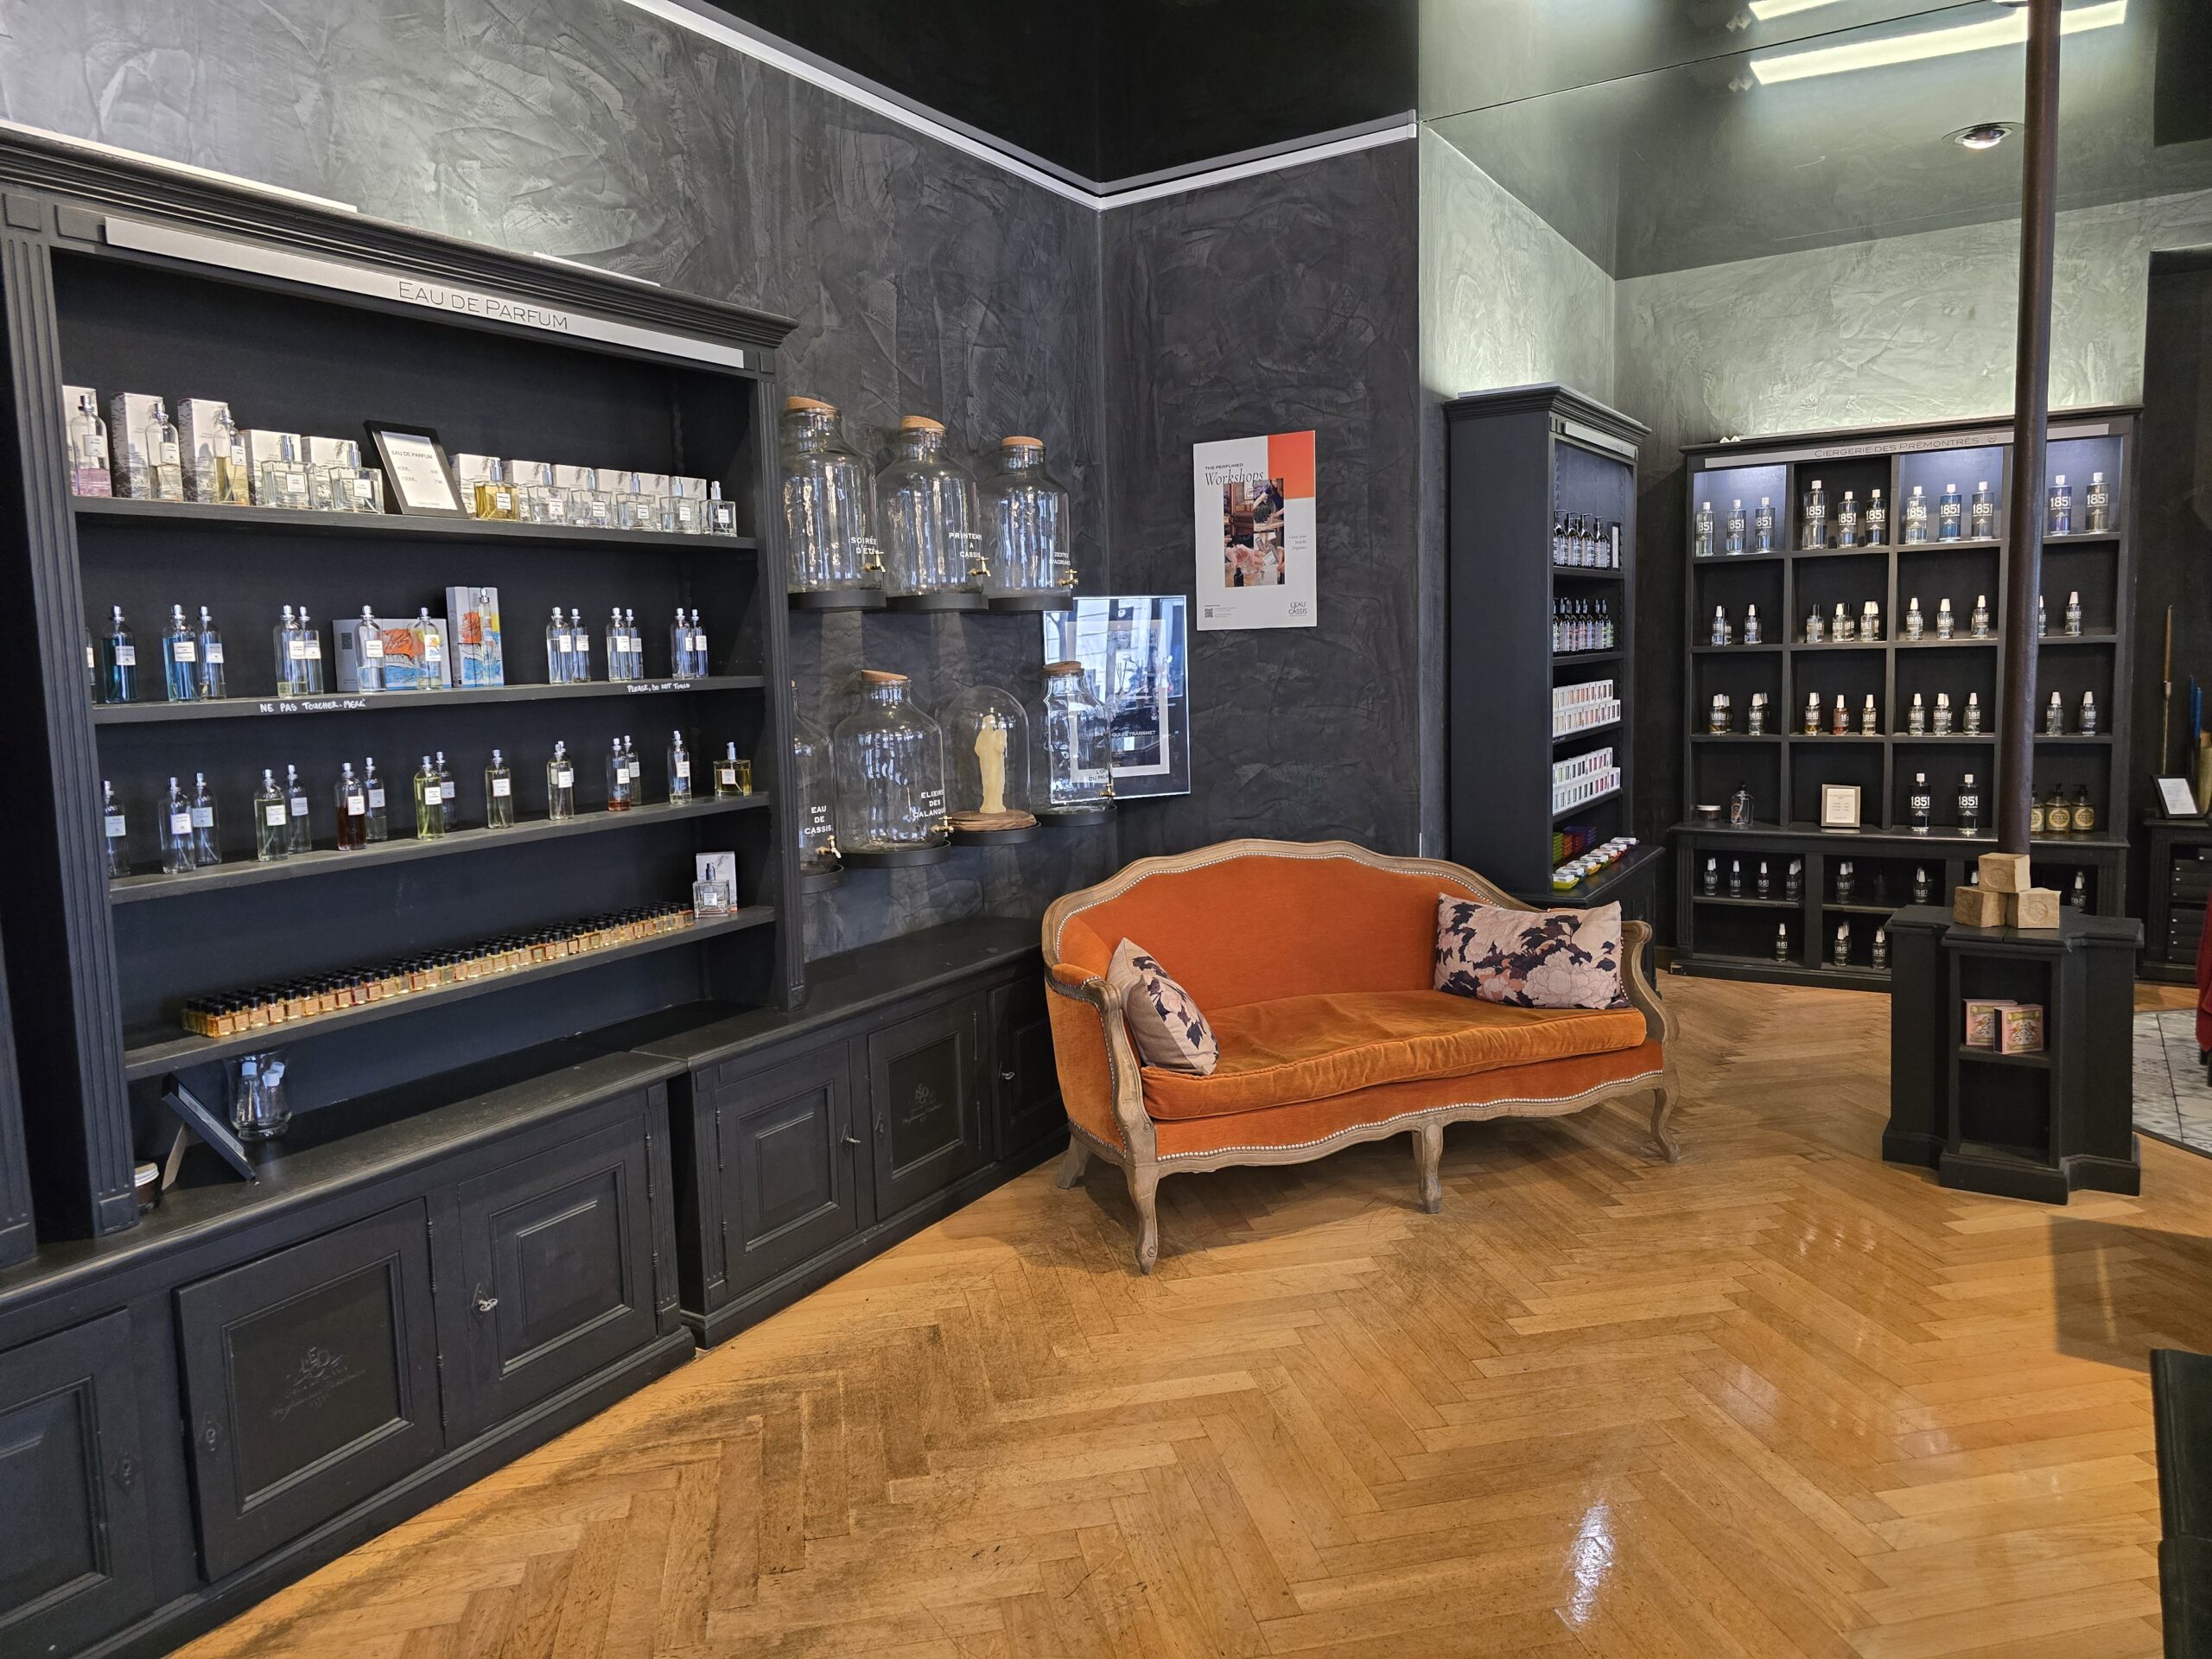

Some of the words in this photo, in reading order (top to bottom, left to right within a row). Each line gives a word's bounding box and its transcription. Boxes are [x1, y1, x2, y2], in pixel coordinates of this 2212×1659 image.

[399, 281, 444, 305] EAU
[451, 294, 480, 313] DE
[486, 299, 568, 330] PARFUM
[1815, 446, 1872, 458] CIERGERIE
[1874, 444, 1897, 453] DES
[1899, 436, 1980, 451] PRÉMONTRÉS
[1205, 467, 1264, 486] Workshops
[2050, 496, 2071, 508] 1851
[2087, 493, 2108, 505] 1851
[1806, 505, 1825, 517] 1851
[1866, 509, 1885, 520] 1851
[1941, 504, 1961, 515] 1851
[1973, 503, 1993, 515] 1851
[1838, 512, 1857, 524] 1851
[1697, 521, 1713, 531] 851
[259, 702, 275, 713] NE
[279, 702, 297, 713] PAS
[1910, 796, 1930, 806] 1851
[1958, 795, 1979, 806] 1851
[810, 805, 827, 814] EAU
